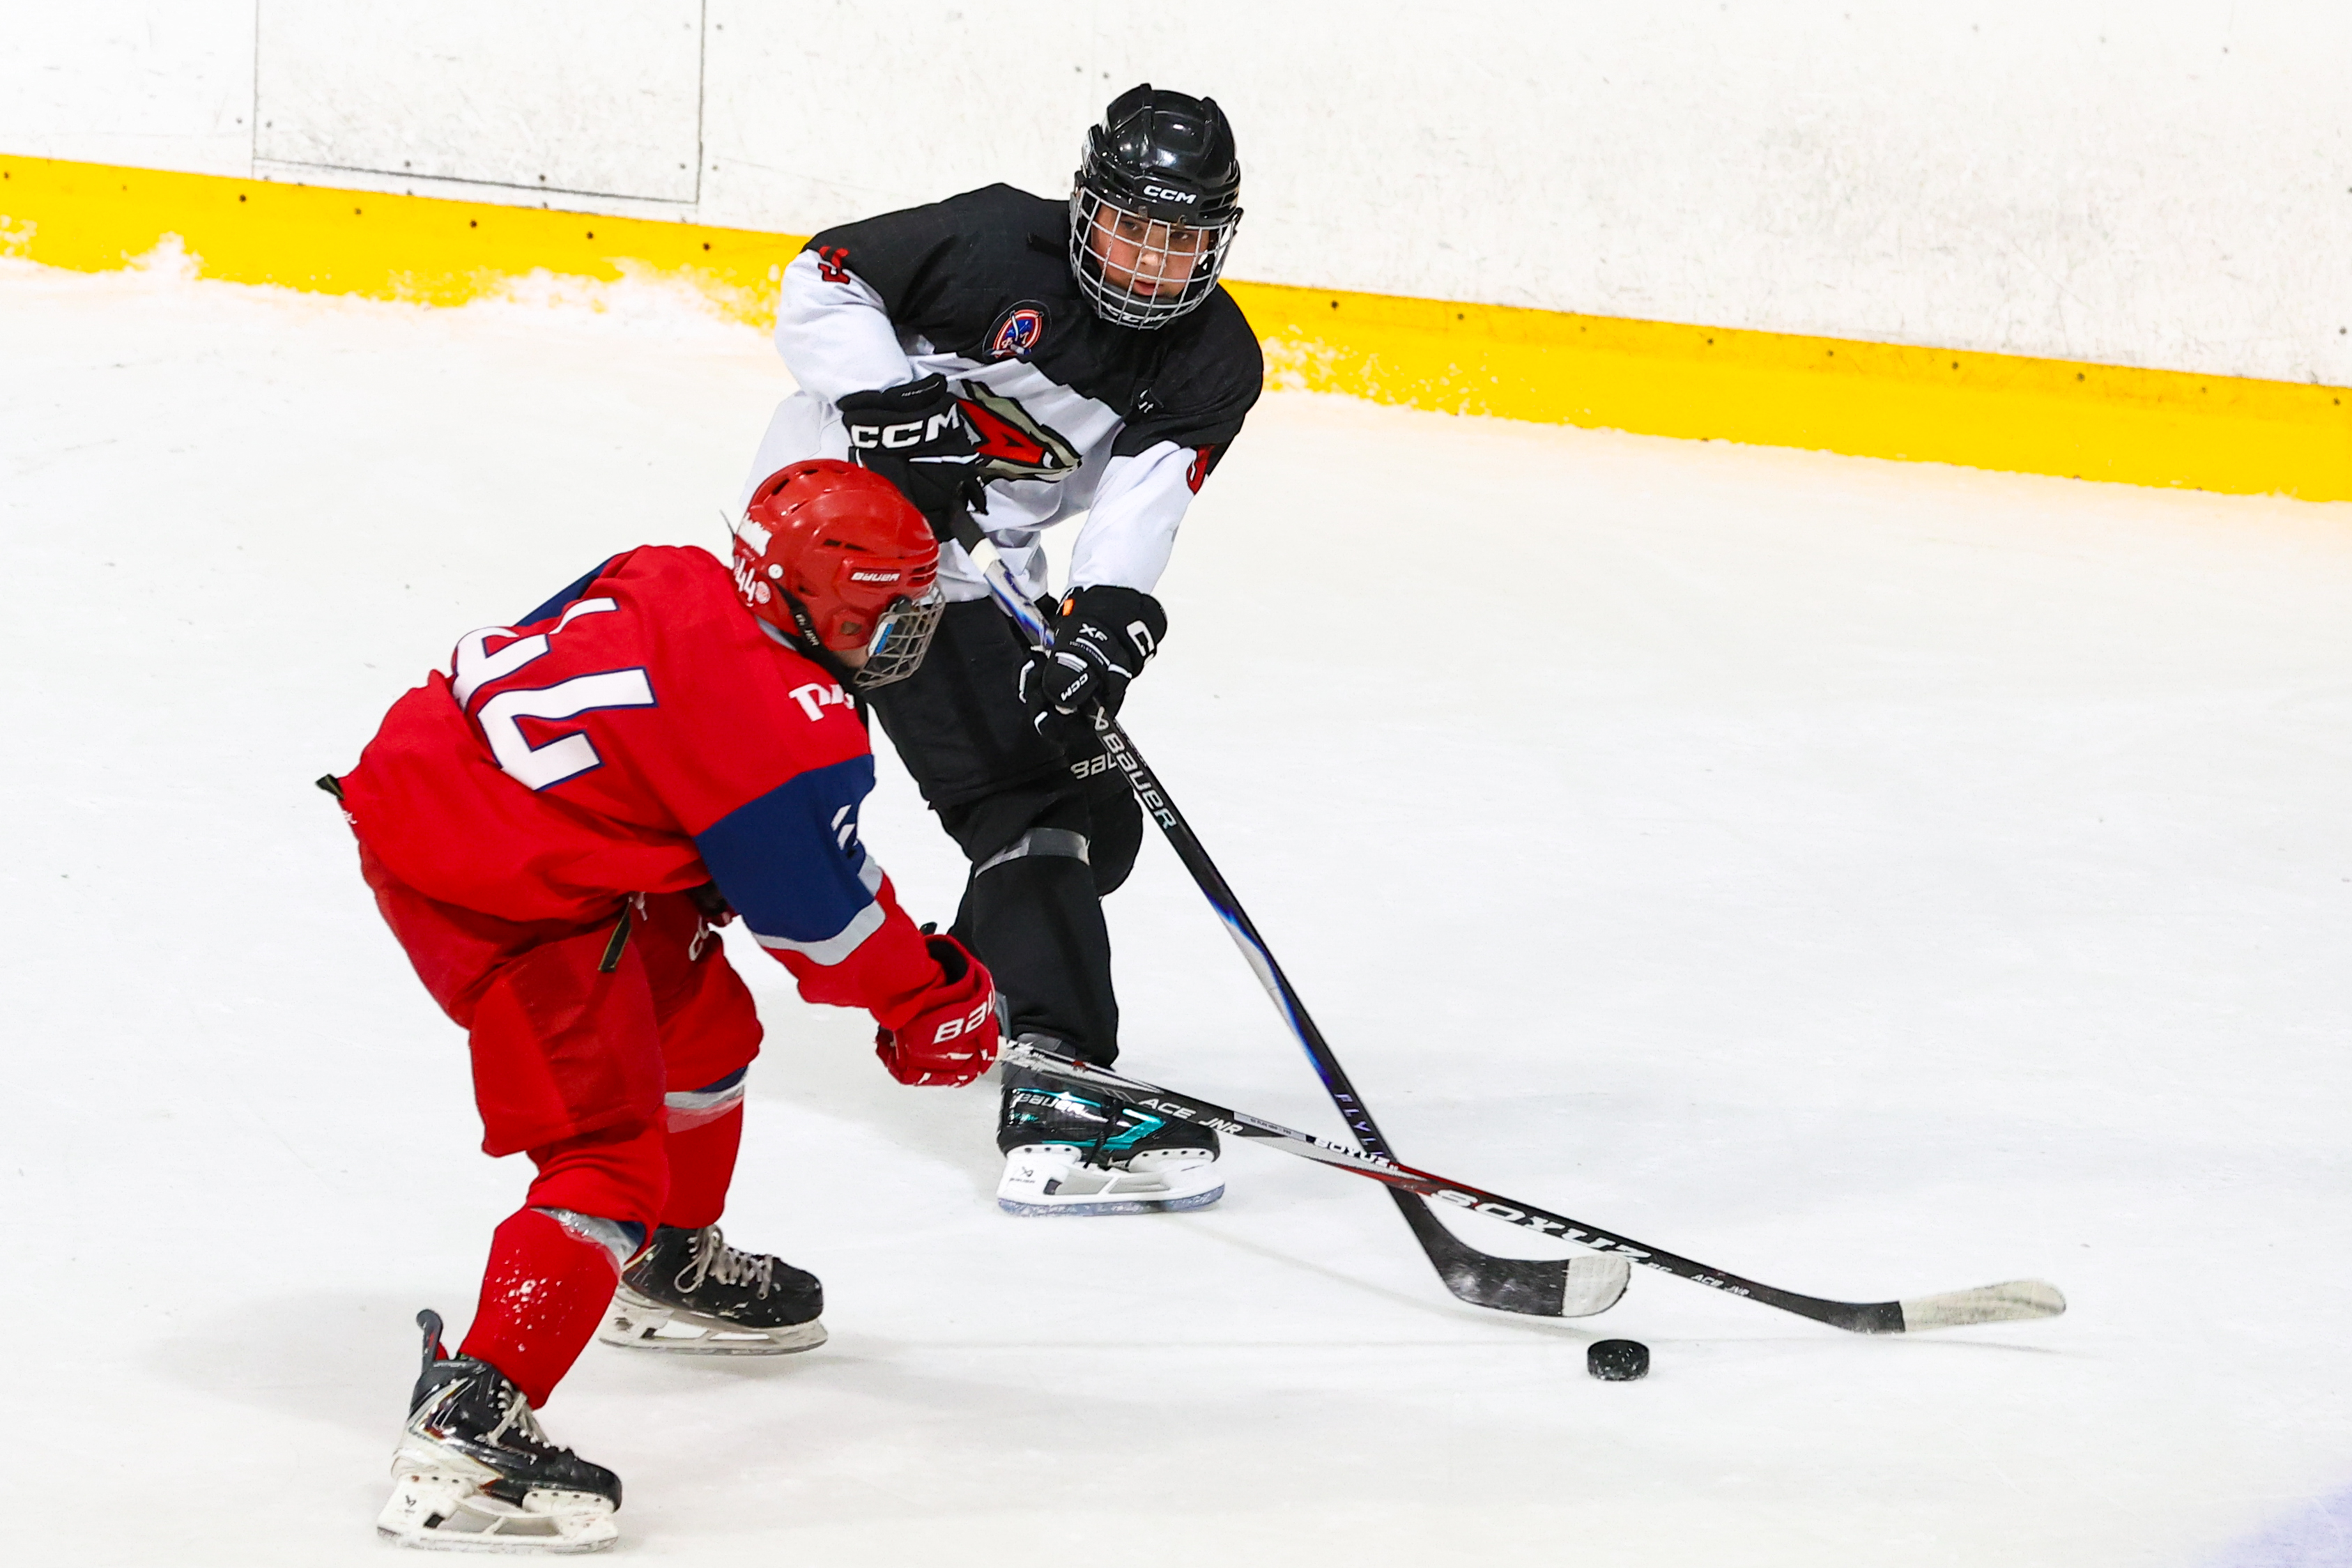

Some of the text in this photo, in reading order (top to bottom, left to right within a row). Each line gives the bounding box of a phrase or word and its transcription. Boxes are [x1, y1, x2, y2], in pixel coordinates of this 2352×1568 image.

[1143, 185, 1197, 205] CCM
[851, 401, 960, 449] CCM
[1079, 622, 1108, 642] XF
[1061, 672, 1089, 702] CCM
[1102, 732, 1177, 829] BAUER
[932, 989, 995, 1045] BAU
[1138, 1098, 1197, 1119] ACE
[1198, 1117, 1243, 1135] JNR
[1314, 1137, 1390, 1168] SOYUZ
[1431, 1189, 1652, 1263] SOYUZ
